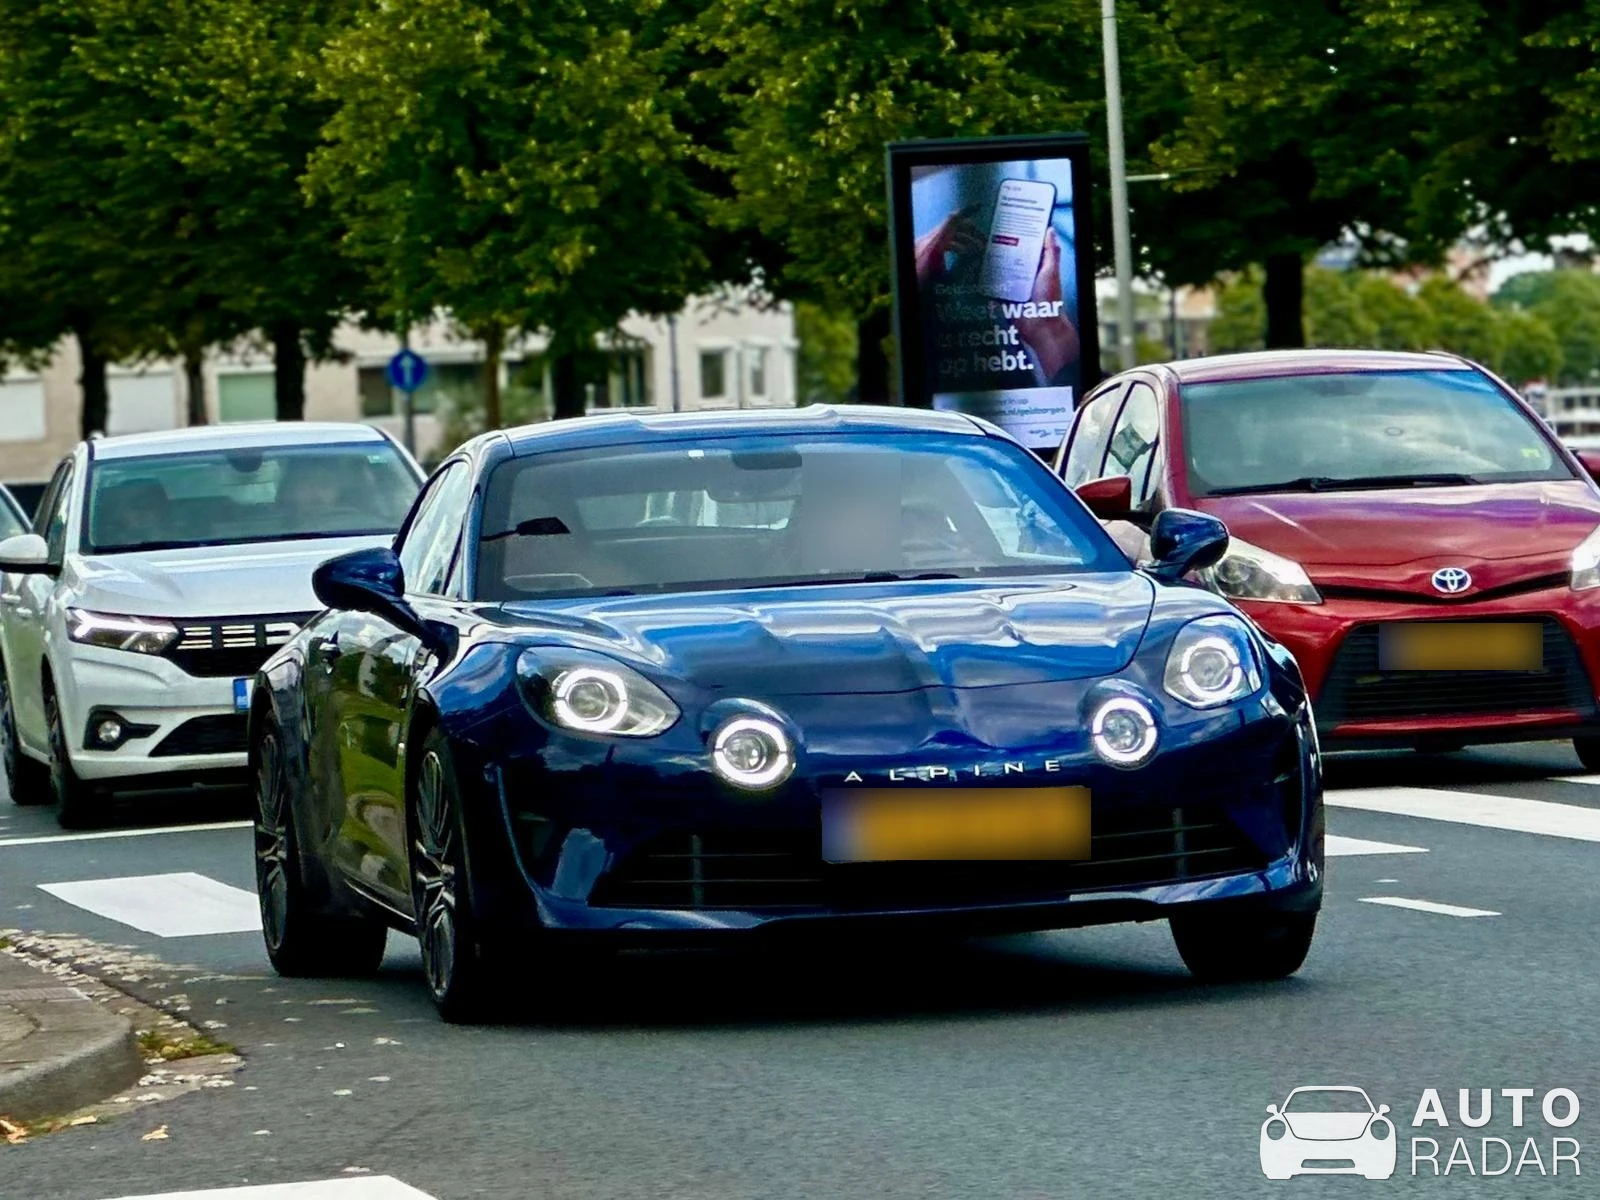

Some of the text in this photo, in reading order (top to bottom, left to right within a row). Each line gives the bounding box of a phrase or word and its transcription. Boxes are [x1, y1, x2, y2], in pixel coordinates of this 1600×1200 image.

[1001, 300, 1064, 319] waar
[957, 324, 1020, 348] recht
[973, 350, 1035, 373] hebt.
[843, 760, 1061, 782] ALPINE
